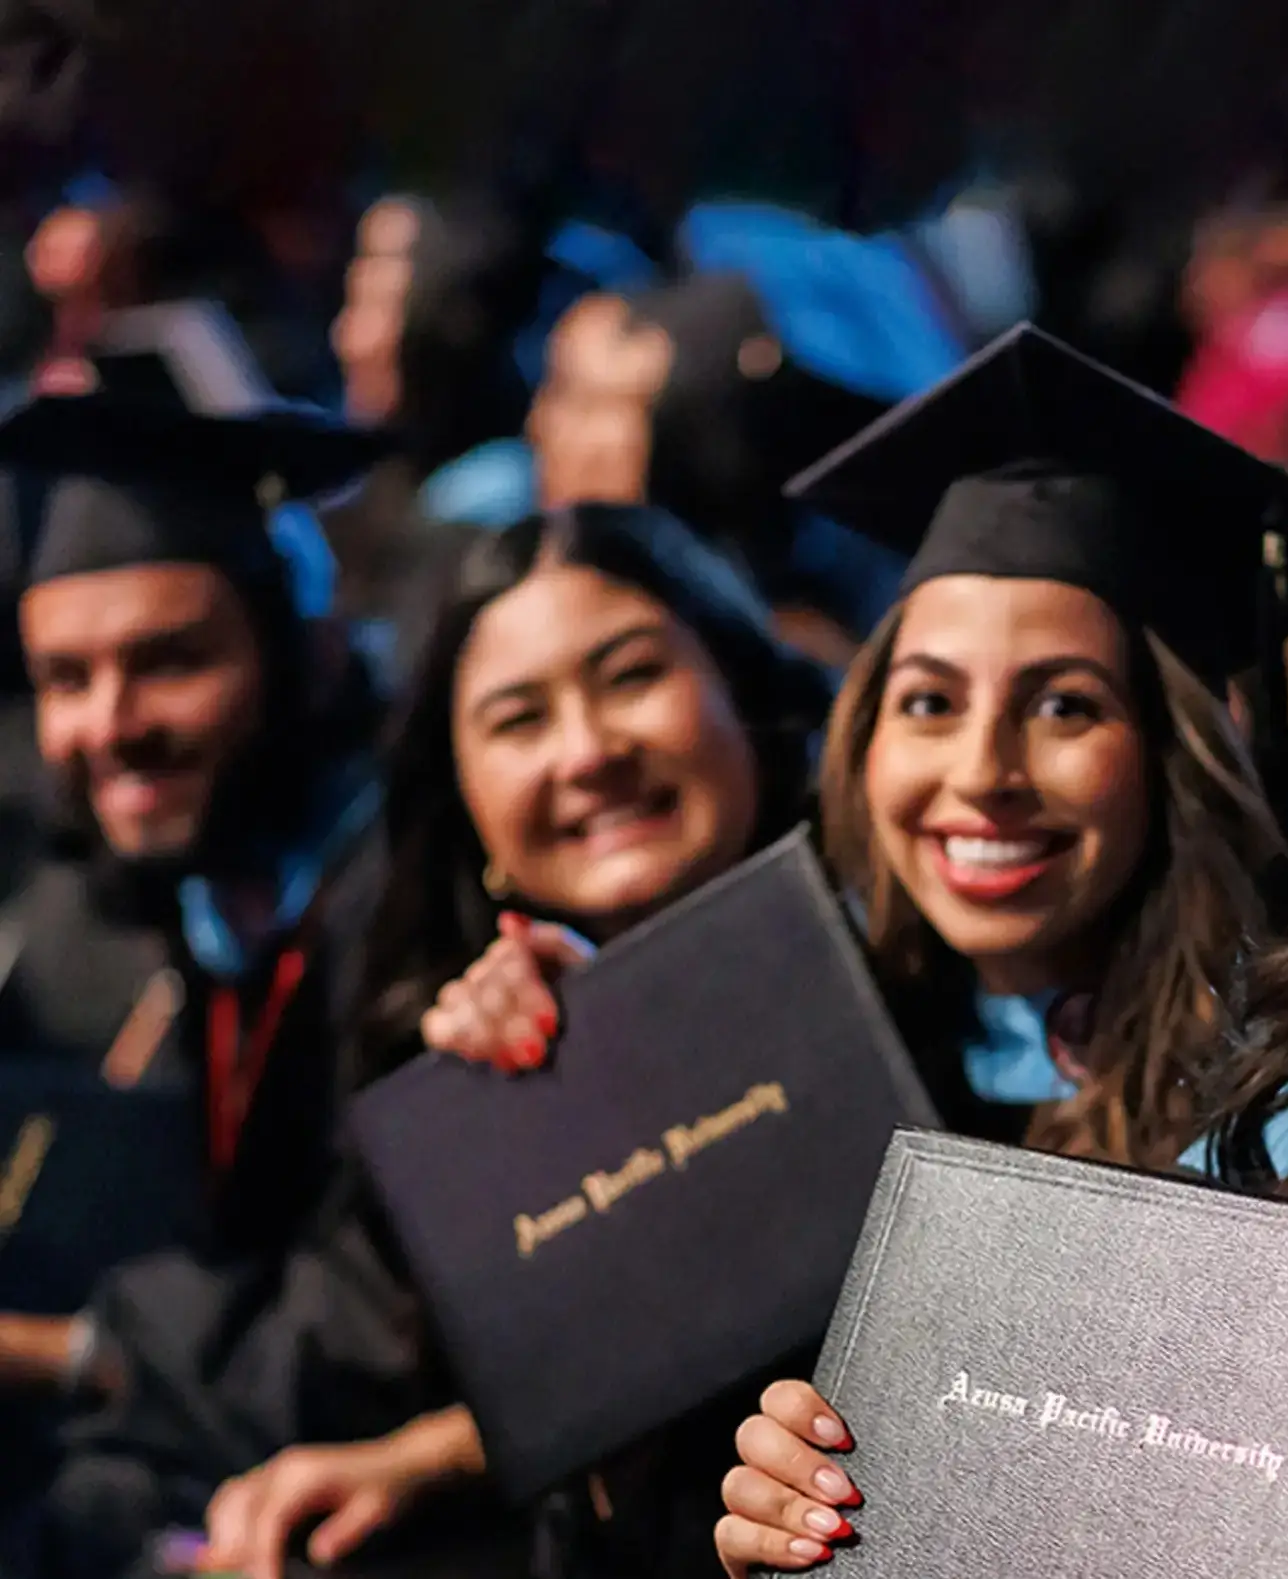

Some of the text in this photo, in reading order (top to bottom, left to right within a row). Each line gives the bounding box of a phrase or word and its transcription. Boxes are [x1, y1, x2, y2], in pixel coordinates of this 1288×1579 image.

[938, 1369, 1284, 1482] Azusa Pacific University
